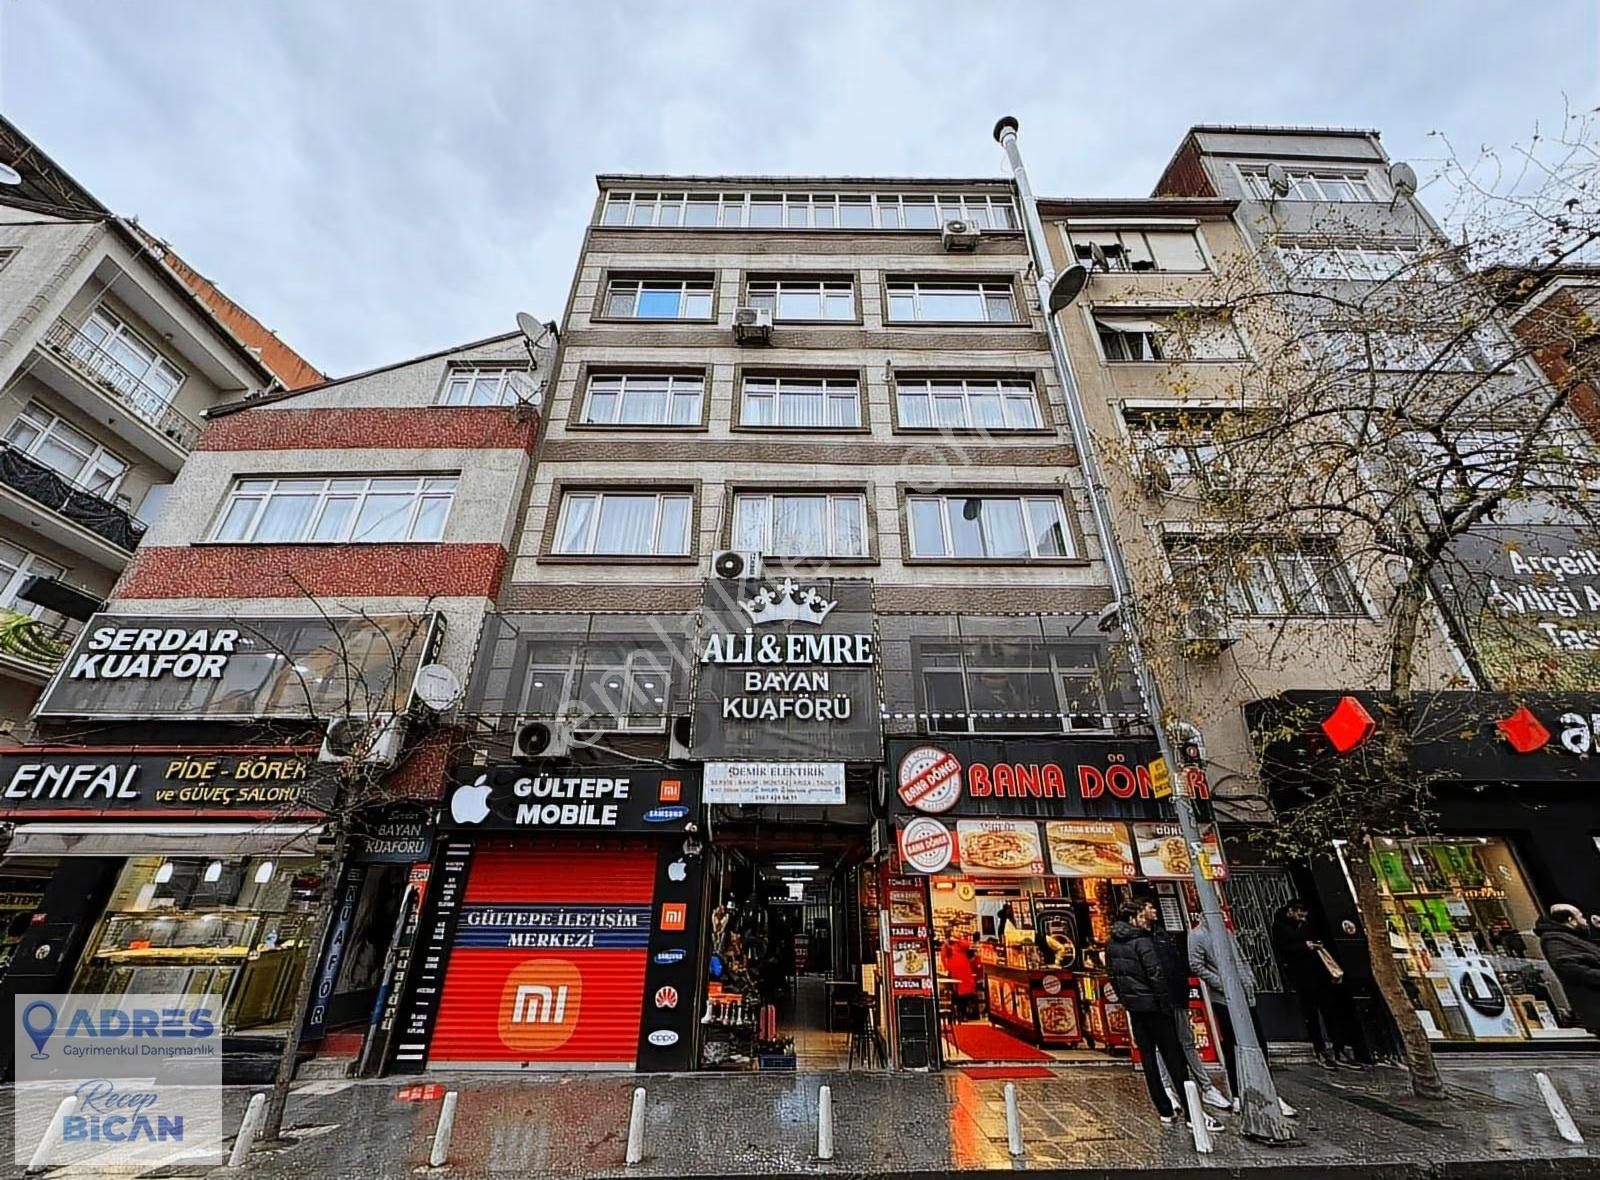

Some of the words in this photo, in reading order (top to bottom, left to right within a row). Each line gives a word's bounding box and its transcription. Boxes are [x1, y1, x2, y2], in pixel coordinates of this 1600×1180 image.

[88, 628, 239, 651] SERDAR
[745, 671, 829, 692] BAYAN
[722, 693, 850, 721] KUAFÖRÜ
[165, 756, 217, 779] PİDE
[234, 756, 306, 780] BÖREK
[968, 763, 1067, 798] BANA
[1078, 753, 1209, 800] DÖNR
[4, 764, 139, 799] ENFAL
[155, 789, 174, 801] ve
[179, 782, 234, 804] GÜVEÇ
[513, 773, 630, 798] GÜLTEPE
[516, 799, 618, 825] MOBİLE
[378, 824, 422, 836] BAYAN
[467, 909, 553, 926] GÜLTEPE
[556, 908, 638, 928] İLETİŞİM
[507, 929, 595, 948] MERKEZİ
